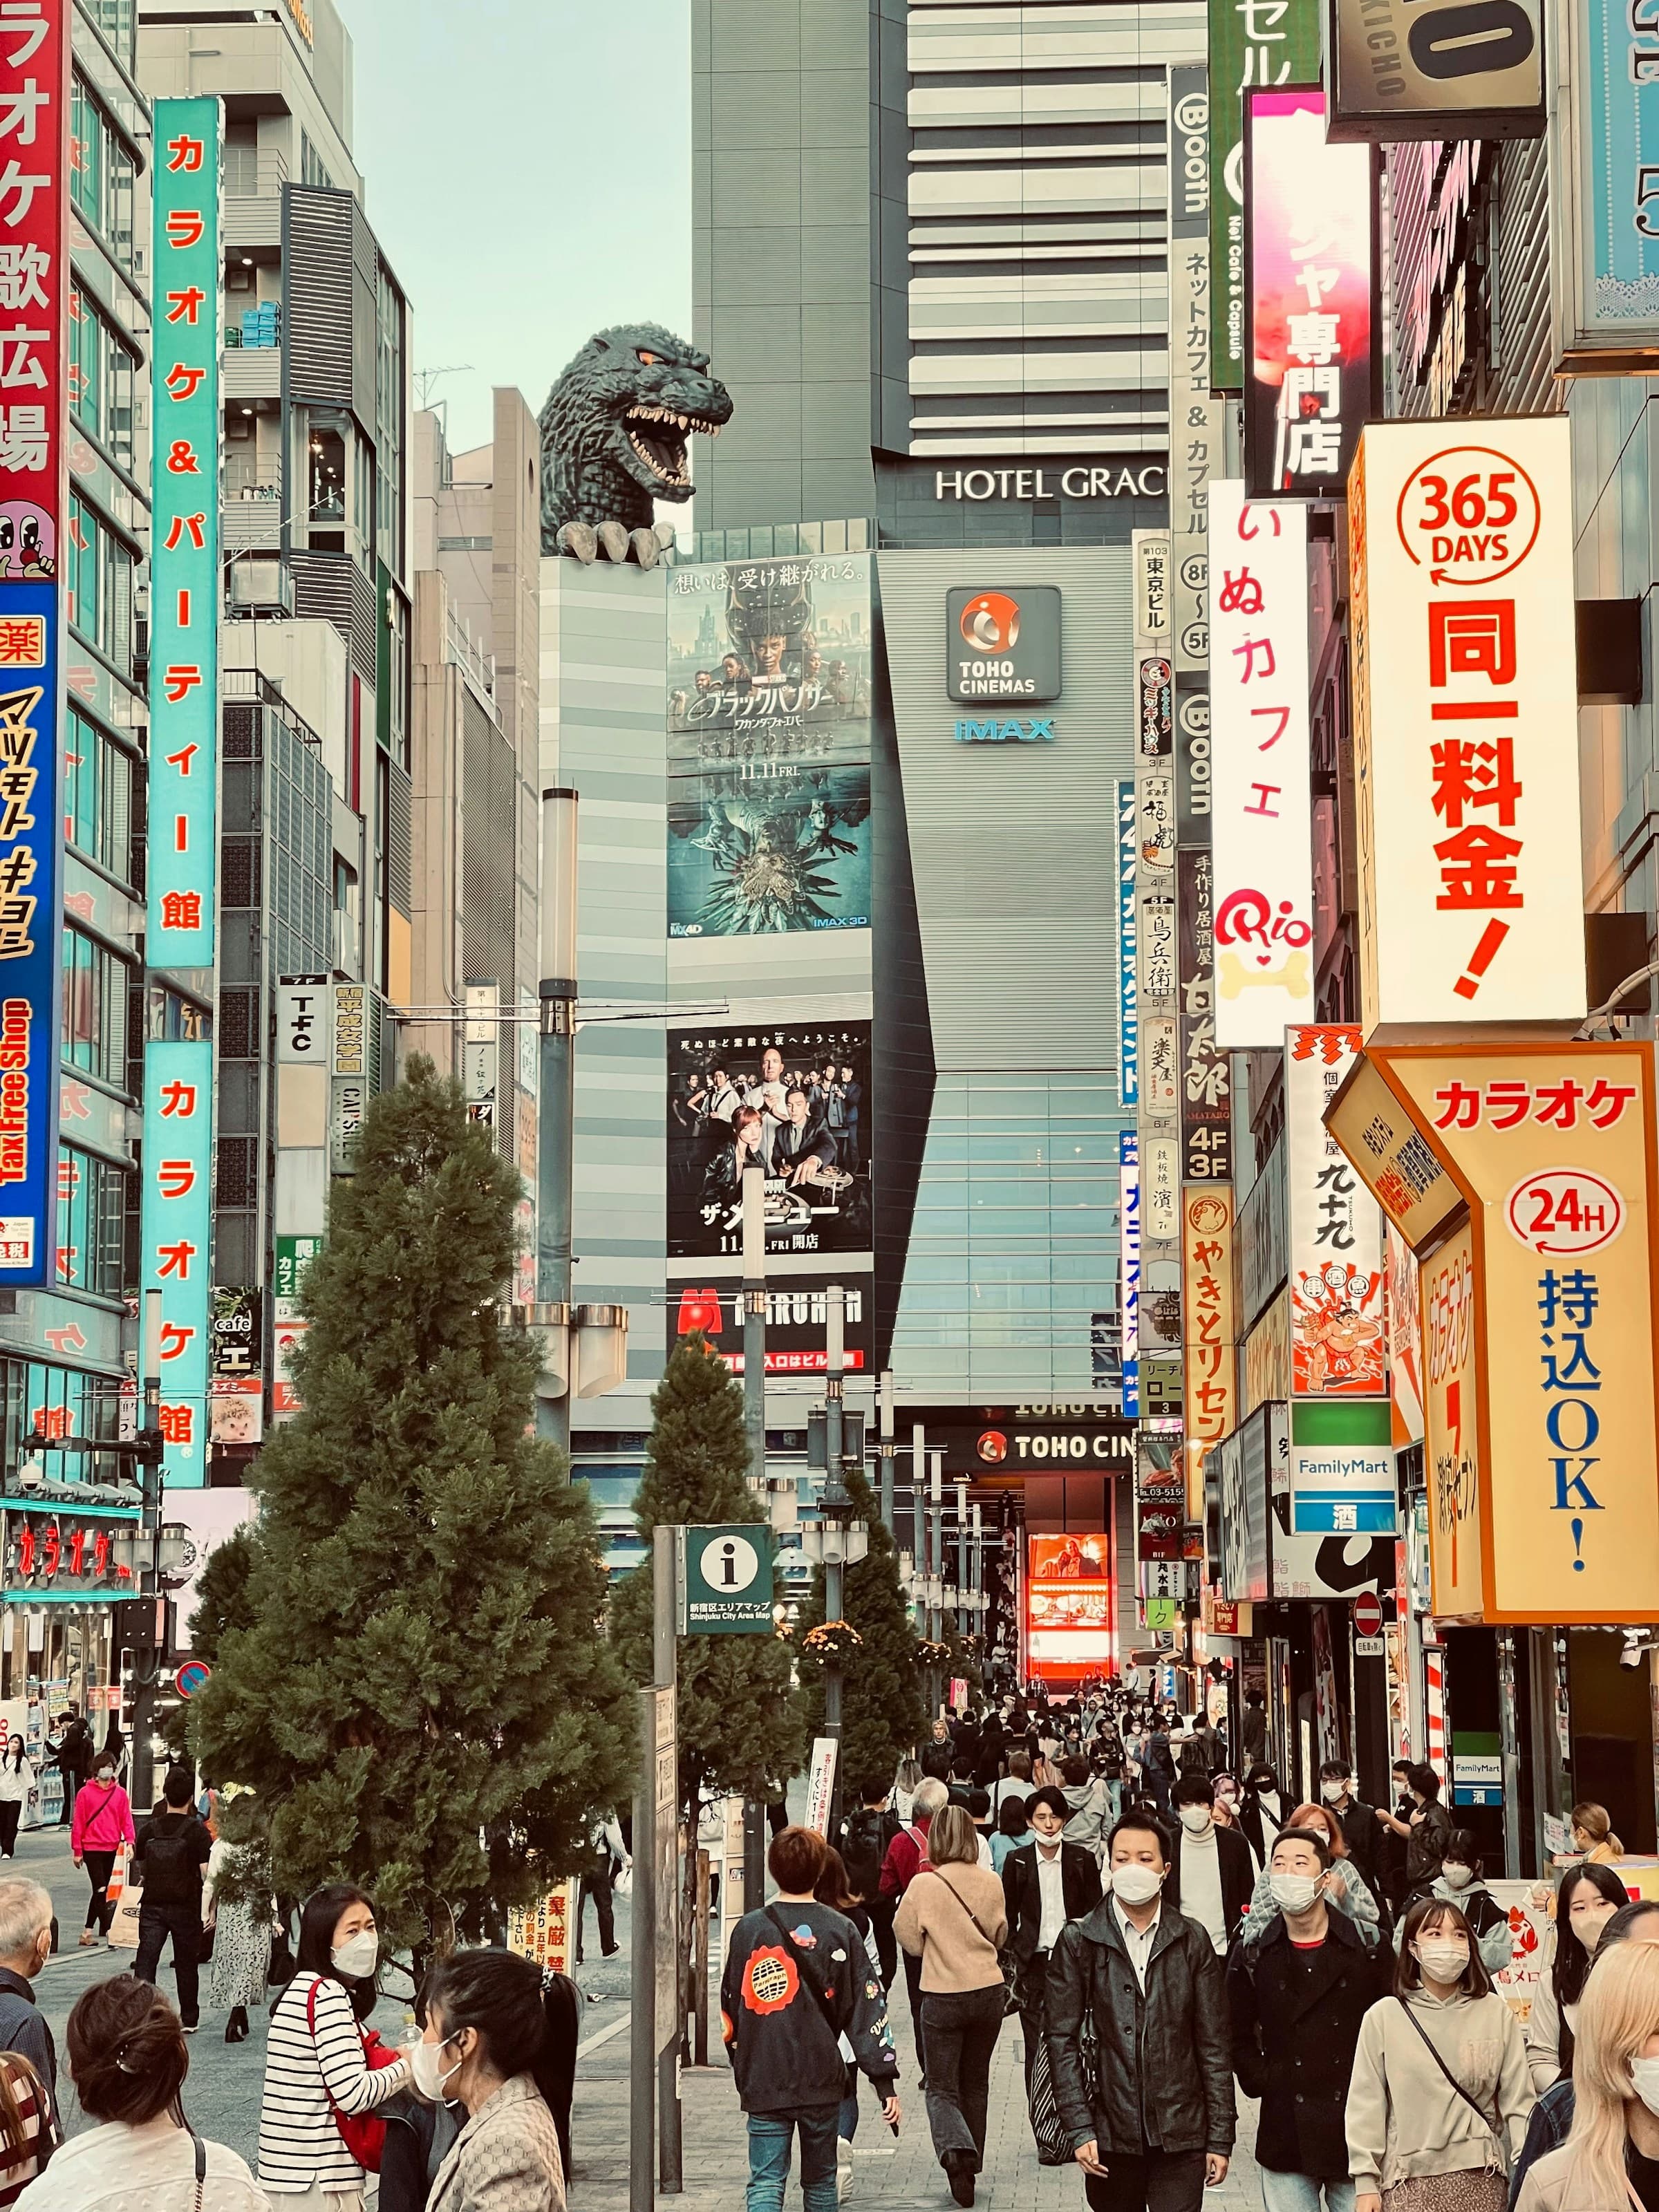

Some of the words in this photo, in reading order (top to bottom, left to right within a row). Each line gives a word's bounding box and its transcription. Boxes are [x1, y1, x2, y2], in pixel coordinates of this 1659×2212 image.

[1186, 253, 1208, 392] ネットカフェ
[1188, 406, 1209, 428] &
[935, 469, 1055, 500] HOTEL
[1061, 466, 1170, 498] GRAC
[1418, 474, 1518, 530] 365
[160, 134, 206, 930] カラオケ&パーティー館
[1432, 535, 1510, 563] DAYS
[674, 564, 863, 596] 想いは、受け継がれる。
[1146, 557, 1165, 628] 東京ビル
[0, 622, 39, 662] 薬
[1219, 503, 1291, 818] いぬカフェ
[959, 660, 1014, 677] TOHO
[959, 679, 1035, 693] CINEMAS
[687, 686, 834, 722] ブラックパンサー
[954, 719, 1056, 740] IMAX
[1428, 599, 1525, 1001] 同一料金!
[0, 690, 39, 957] マツモトキヨシ
[813, 918, 847, 928] IMAX
[849, 916, 868, 926] 3D
[1194, 854, 1214, 966] 手作り居酒屋
[1213, 888, 1311, 948] Rio
[1, 998, 30, 1070] Shop
[0, 1072, 27, 1134] Free
[1434, 1079, 1636, 1131] カラオケ
[1188, 1127, 1228, 1151] 4F
[0, 1134, 26, 1184] Tax
[1188, 1154, 1228, 1177] 3F
[1313, 1163, 1356, 1250] 九十九
[1529, 1185, 1605, 1234] 24H
[792, 1234, 818, 1250] 開店
[156, 1080, 196, 1444] カラオケ館
[278, 1256, 292, 1295] カフェ
[215, 1316, 251, 1331] cafe
[1430, 1248, 1474, 1389] カラオケ
[1537, 1268, 1607, 1572] 持込OK!
[1015, 1436, 1087, 1459] TOHO
[1299, 1459, 1389, 1477] FamilyMart
[1446, 1380, 1462, 1588] 7
[1332, 1504, 1358, 1531] 酒
[690, 1601, 771, 1613] 新宿区エリアマップ
[690, 1613, 721, 1622] Shinjuku
[722, 1612, 736, 1621] City
[756, 1611, 771, 1620] Map
[1455, 1763, 1500, 1774] FamilyMart
[1472, 1790, 1486, 1804] 酒
[753, 1972, 787, 1989] Paragraph
